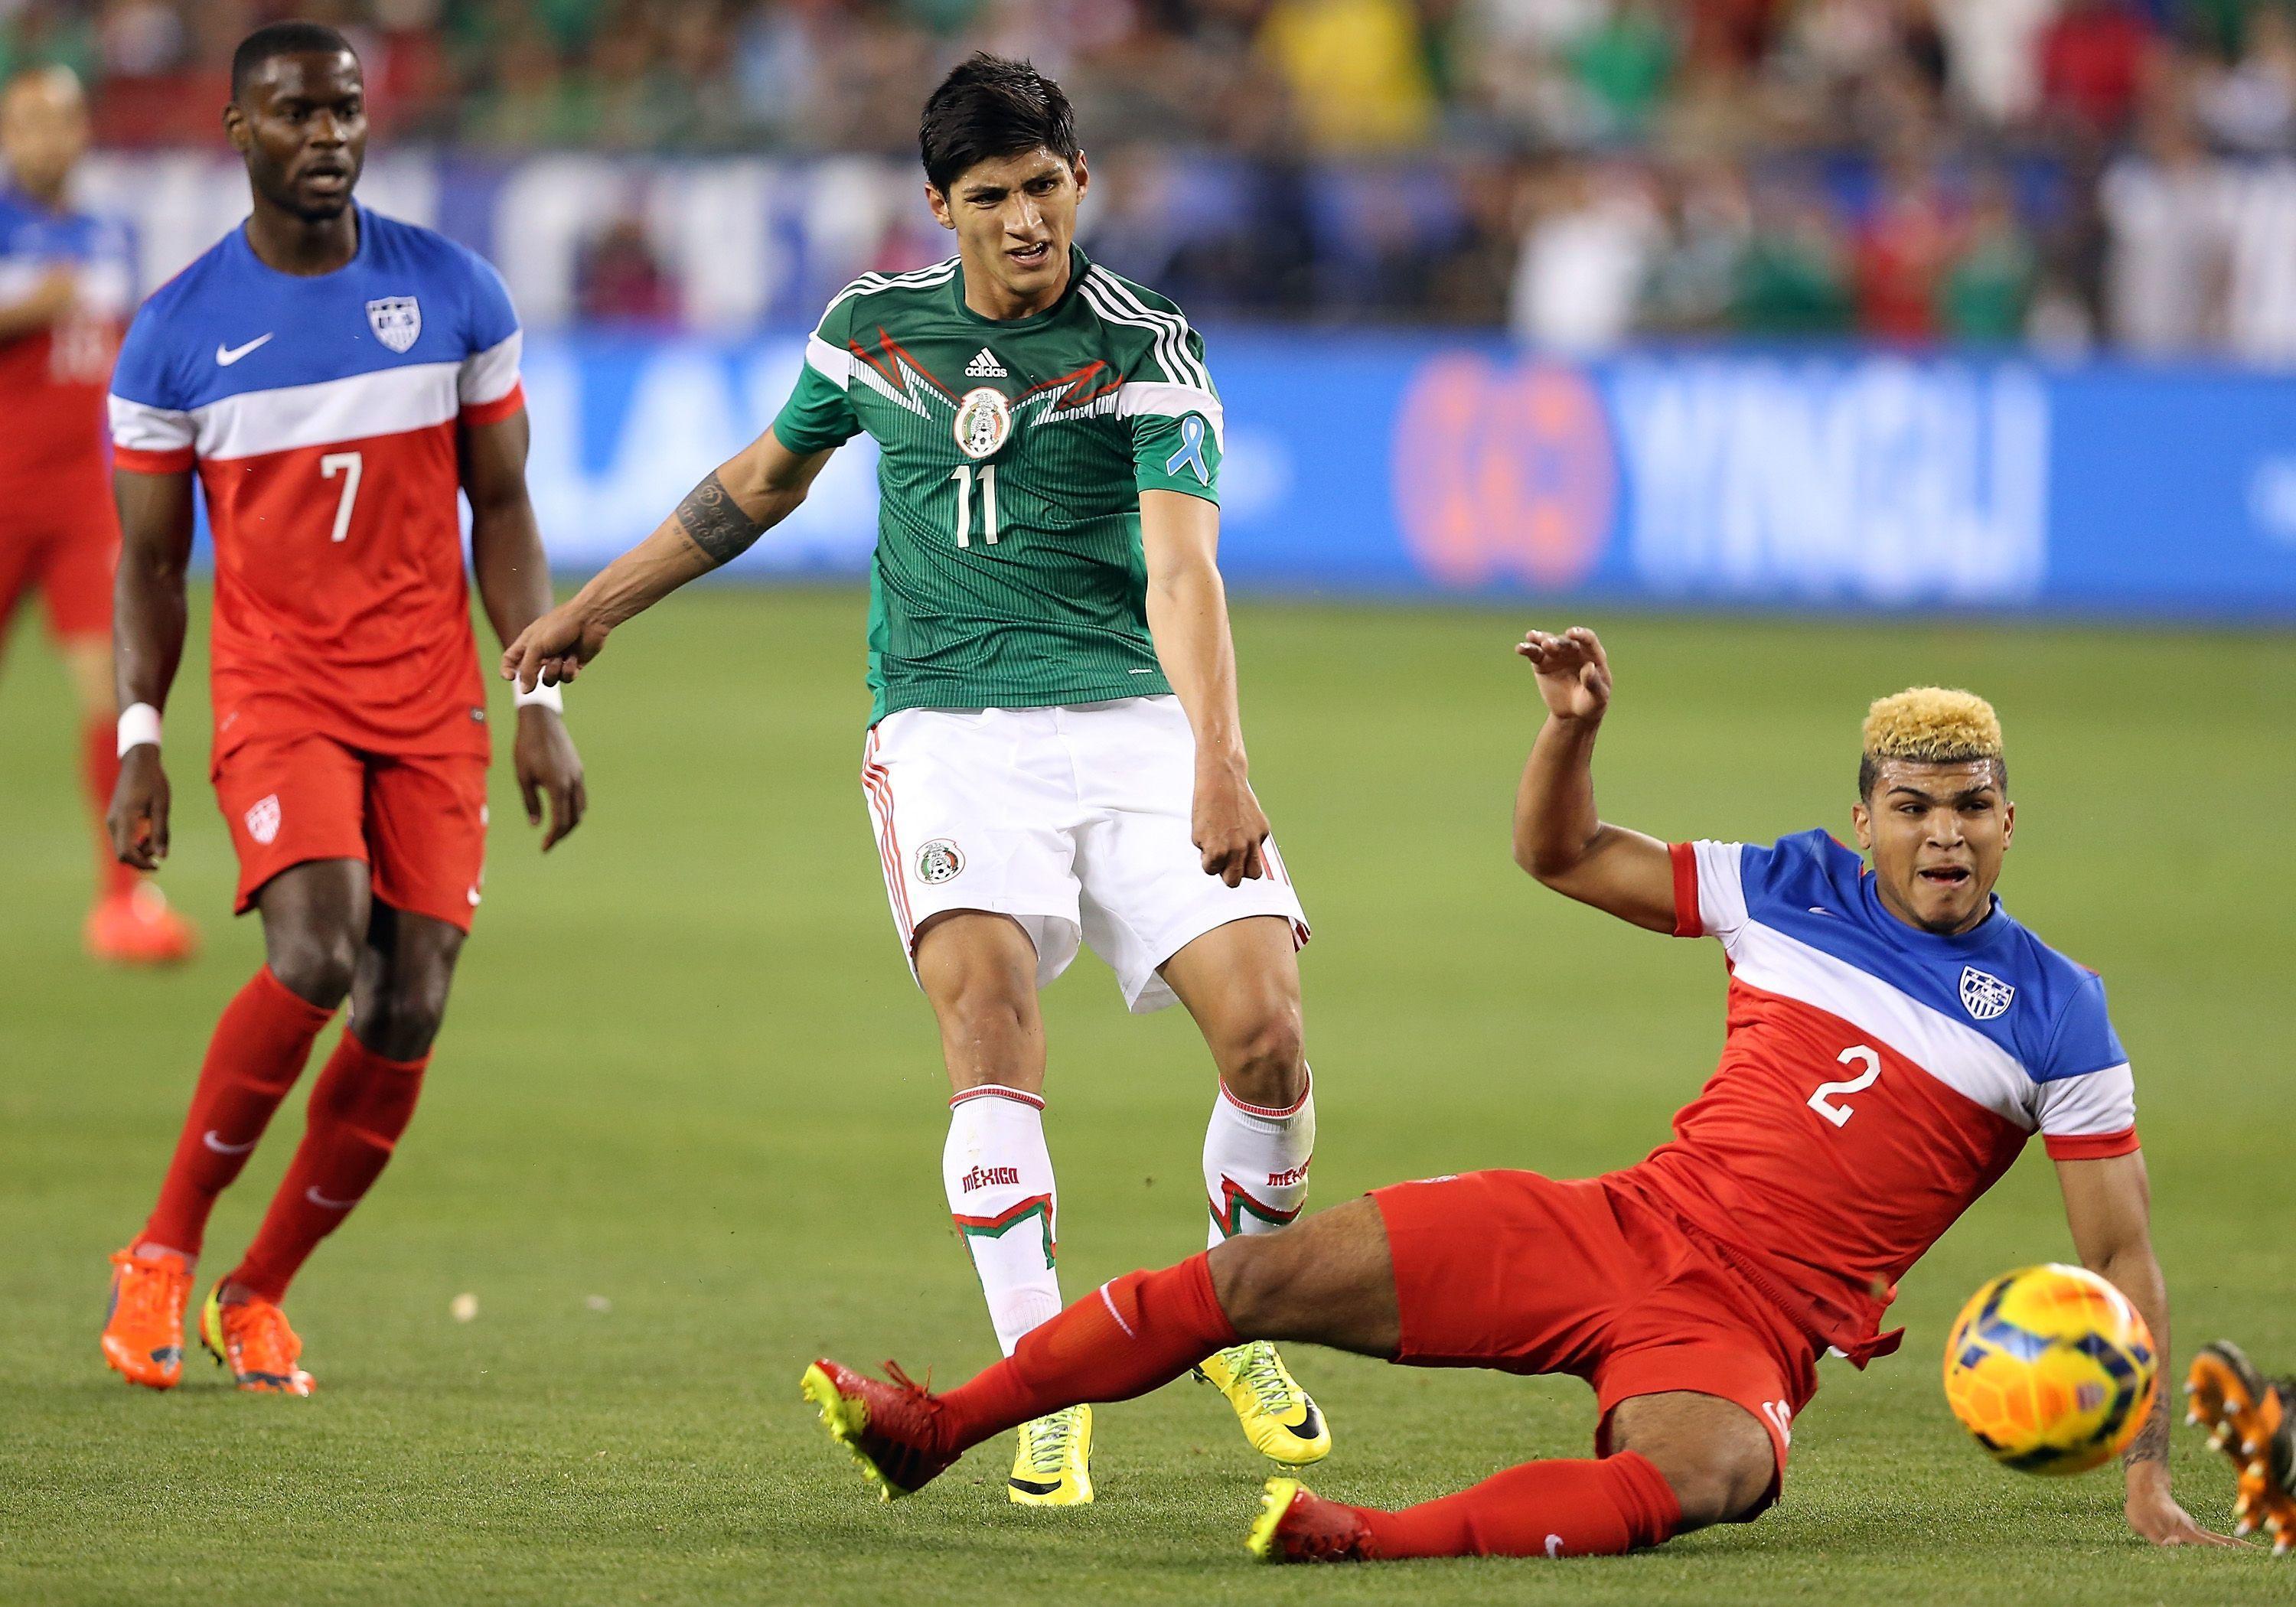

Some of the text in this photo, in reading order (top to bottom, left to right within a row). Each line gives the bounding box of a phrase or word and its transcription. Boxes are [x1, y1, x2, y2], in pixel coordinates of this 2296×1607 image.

[964, 366, 1008, 378] adidas
[321, 452, 362, 542] 7
[951, 464, 998, 549] 11
[1807, 1045, 1881, 1128] 2
[962, 1165, 1020, 1194] MÉXICO
